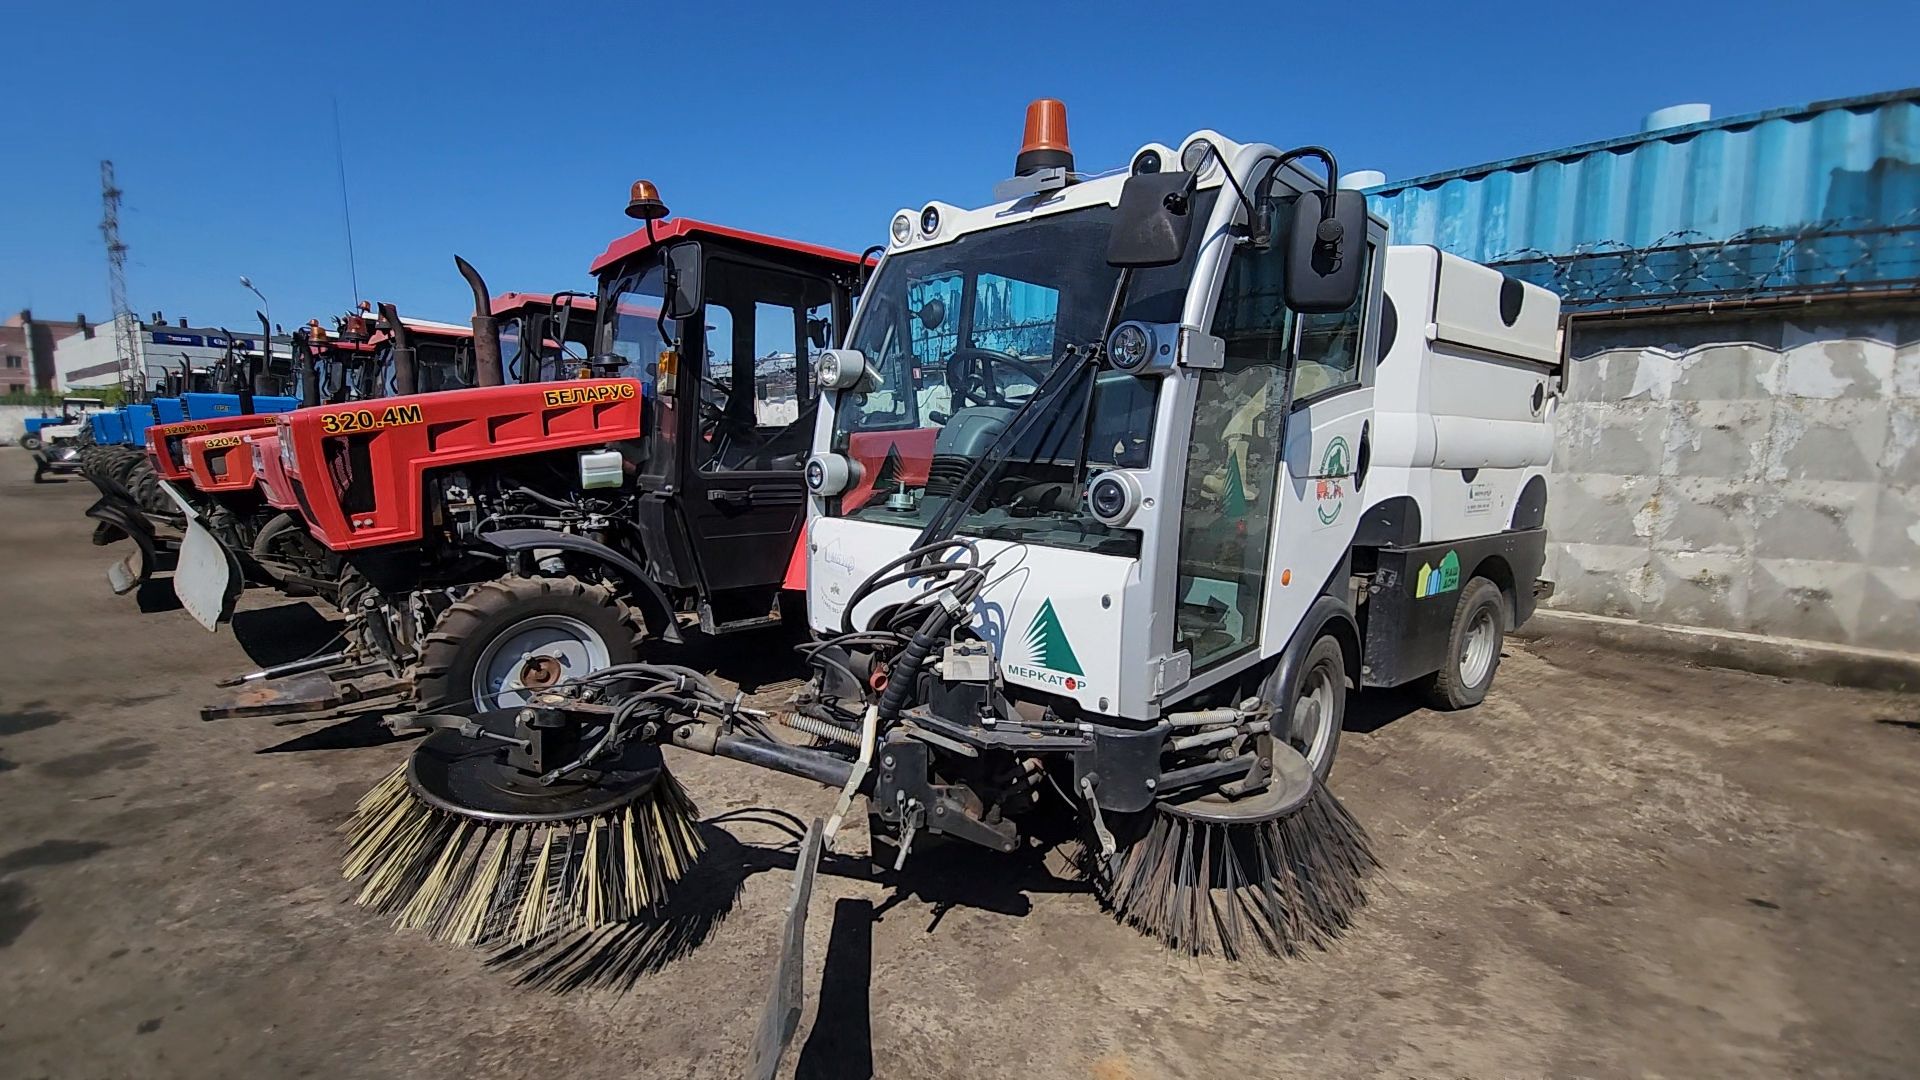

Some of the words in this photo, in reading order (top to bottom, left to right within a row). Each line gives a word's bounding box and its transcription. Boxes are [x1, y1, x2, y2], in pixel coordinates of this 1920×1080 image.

[543, 383, 634, 407] БЕЛАРУС
[205, 436, 241, 448] 320.4
[1445, 566, 1458, 577] НАШ
[1443, 577, 1458, 589] ДОМ
